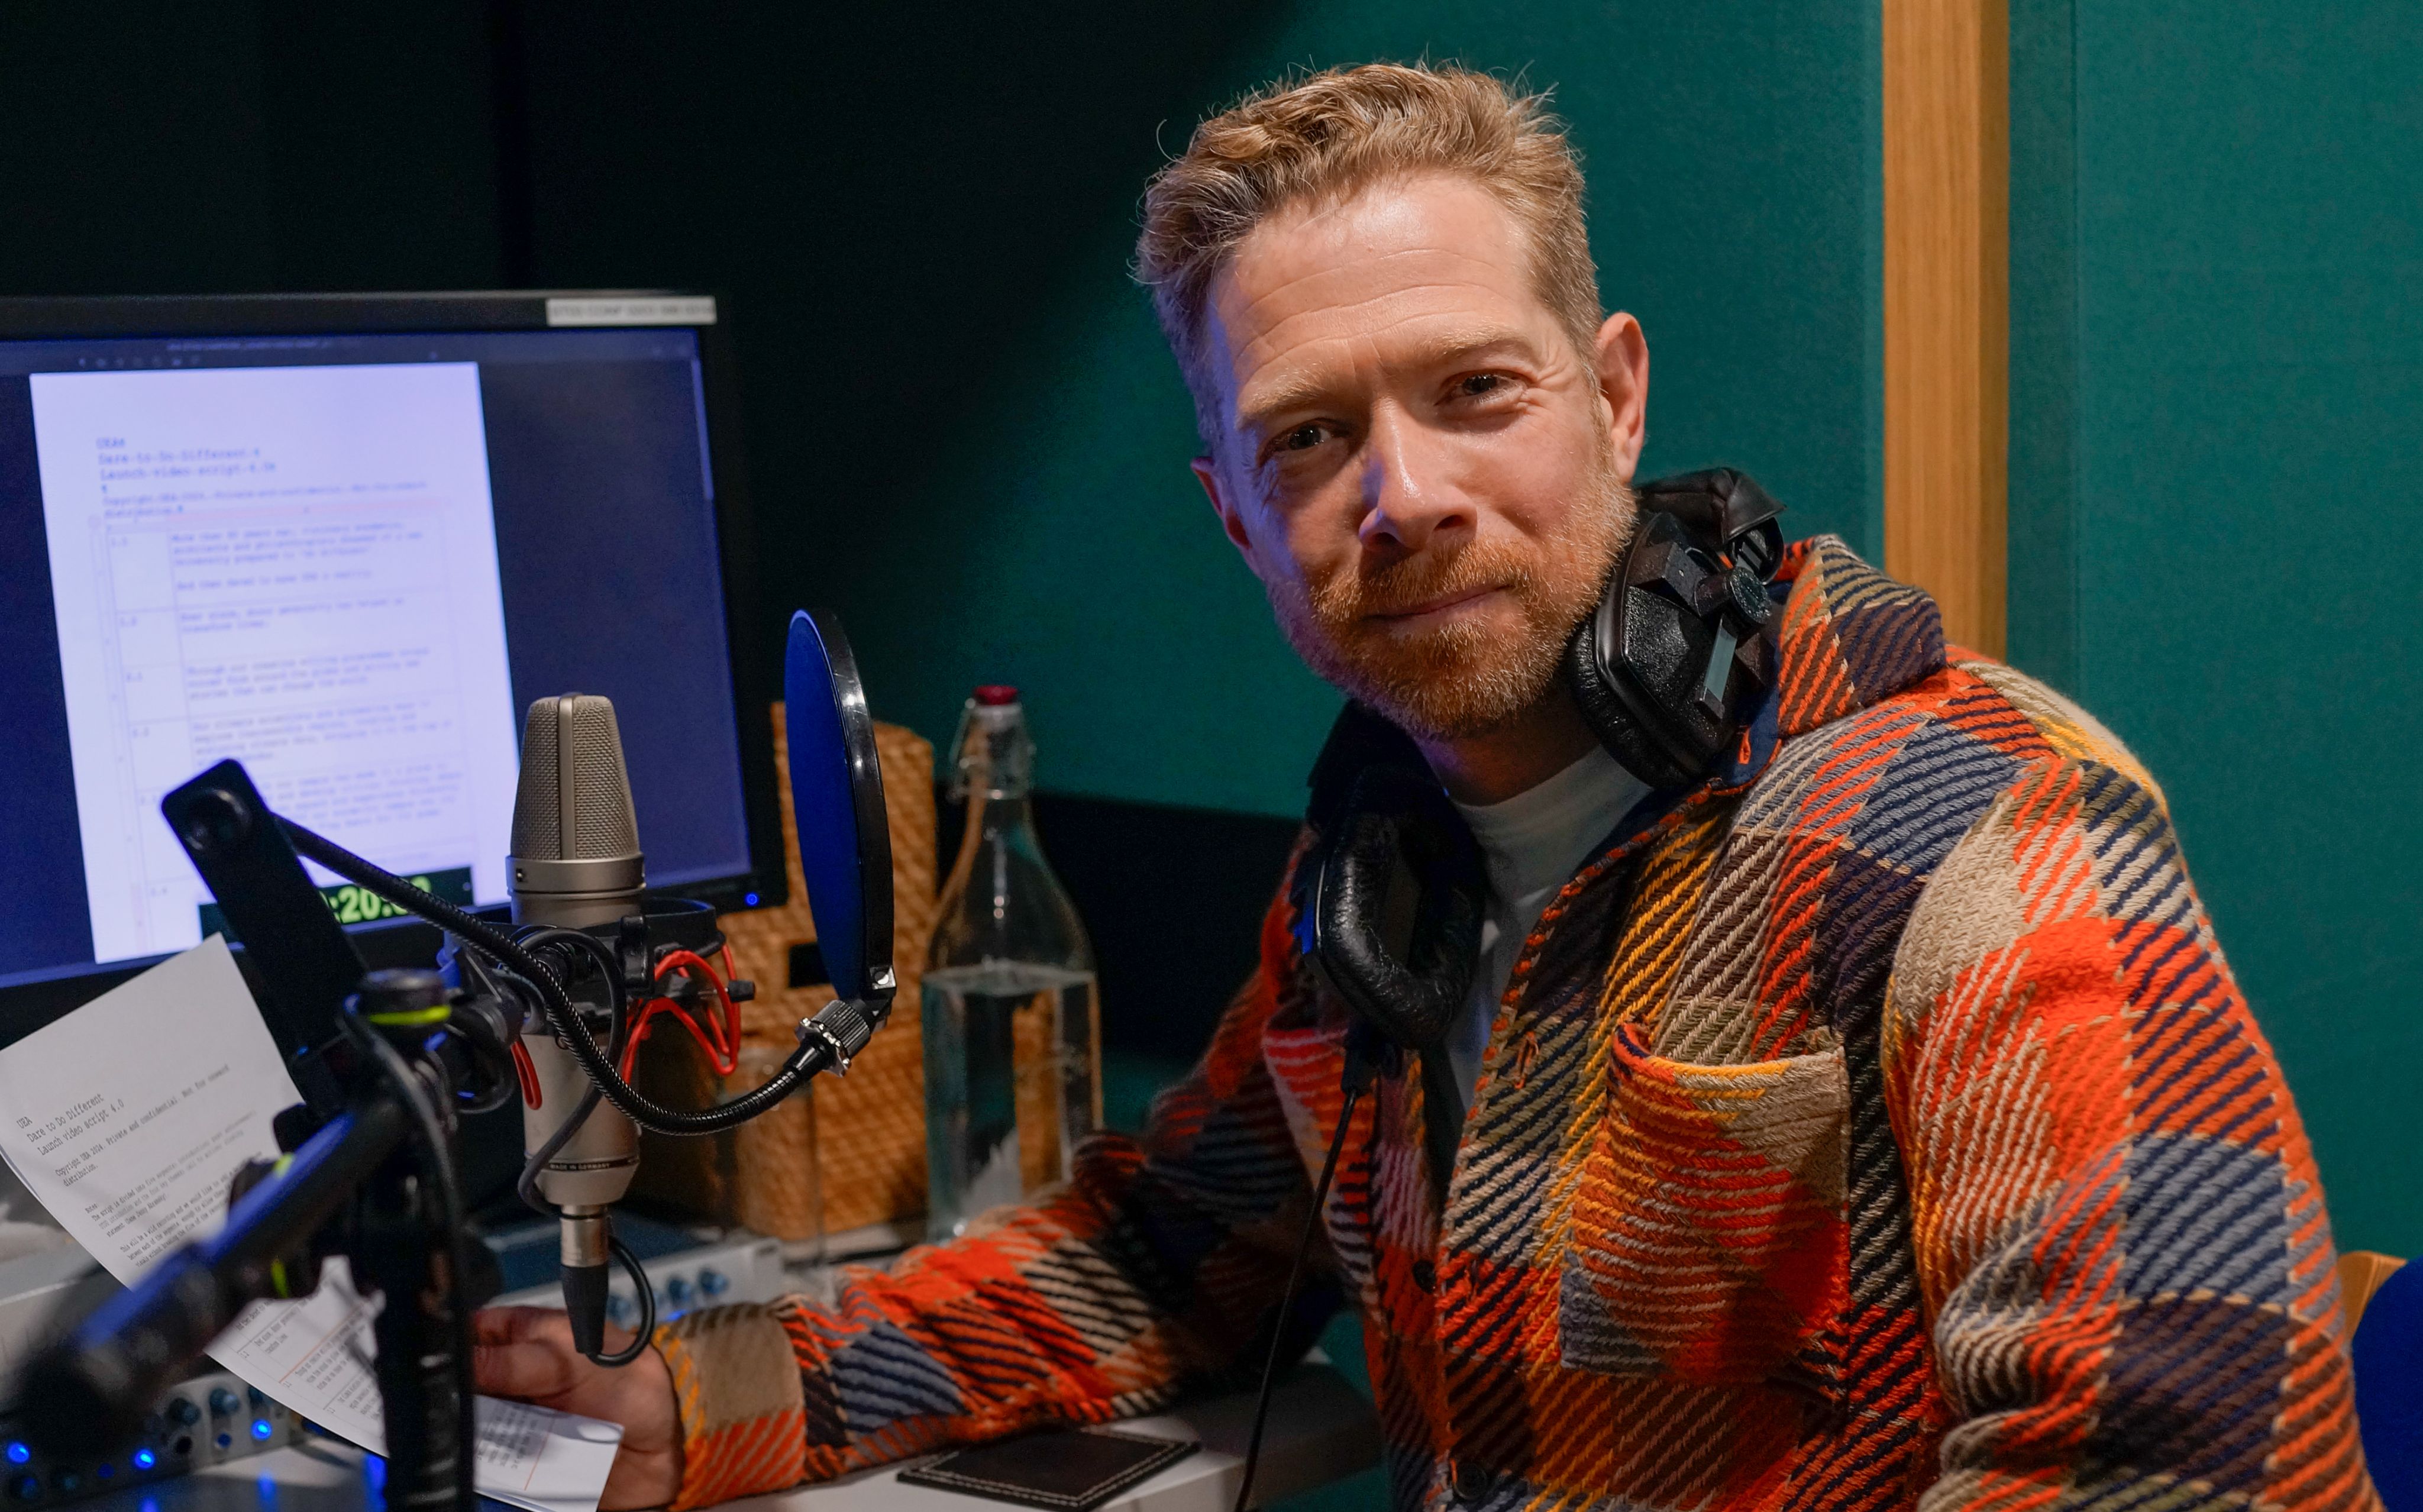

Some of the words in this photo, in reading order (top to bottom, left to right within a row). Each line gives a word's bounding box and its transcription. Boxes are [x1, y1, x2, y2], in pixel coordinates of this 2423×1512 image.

[16, 1116, 33, 1129] UEA
[27, 1126, 46, 1142] Dare
[46, 1122, 56, 1132] to
[55, 1116, 66, 1127] Do
[65, 1093, 105, 1120] Different
[37, 1136, 63, 1156] Launch
[63, 1124, 83, 1141] video
[84, 1109, 109, 1129] script
[110, 1099, 125, 1113] 4.0
